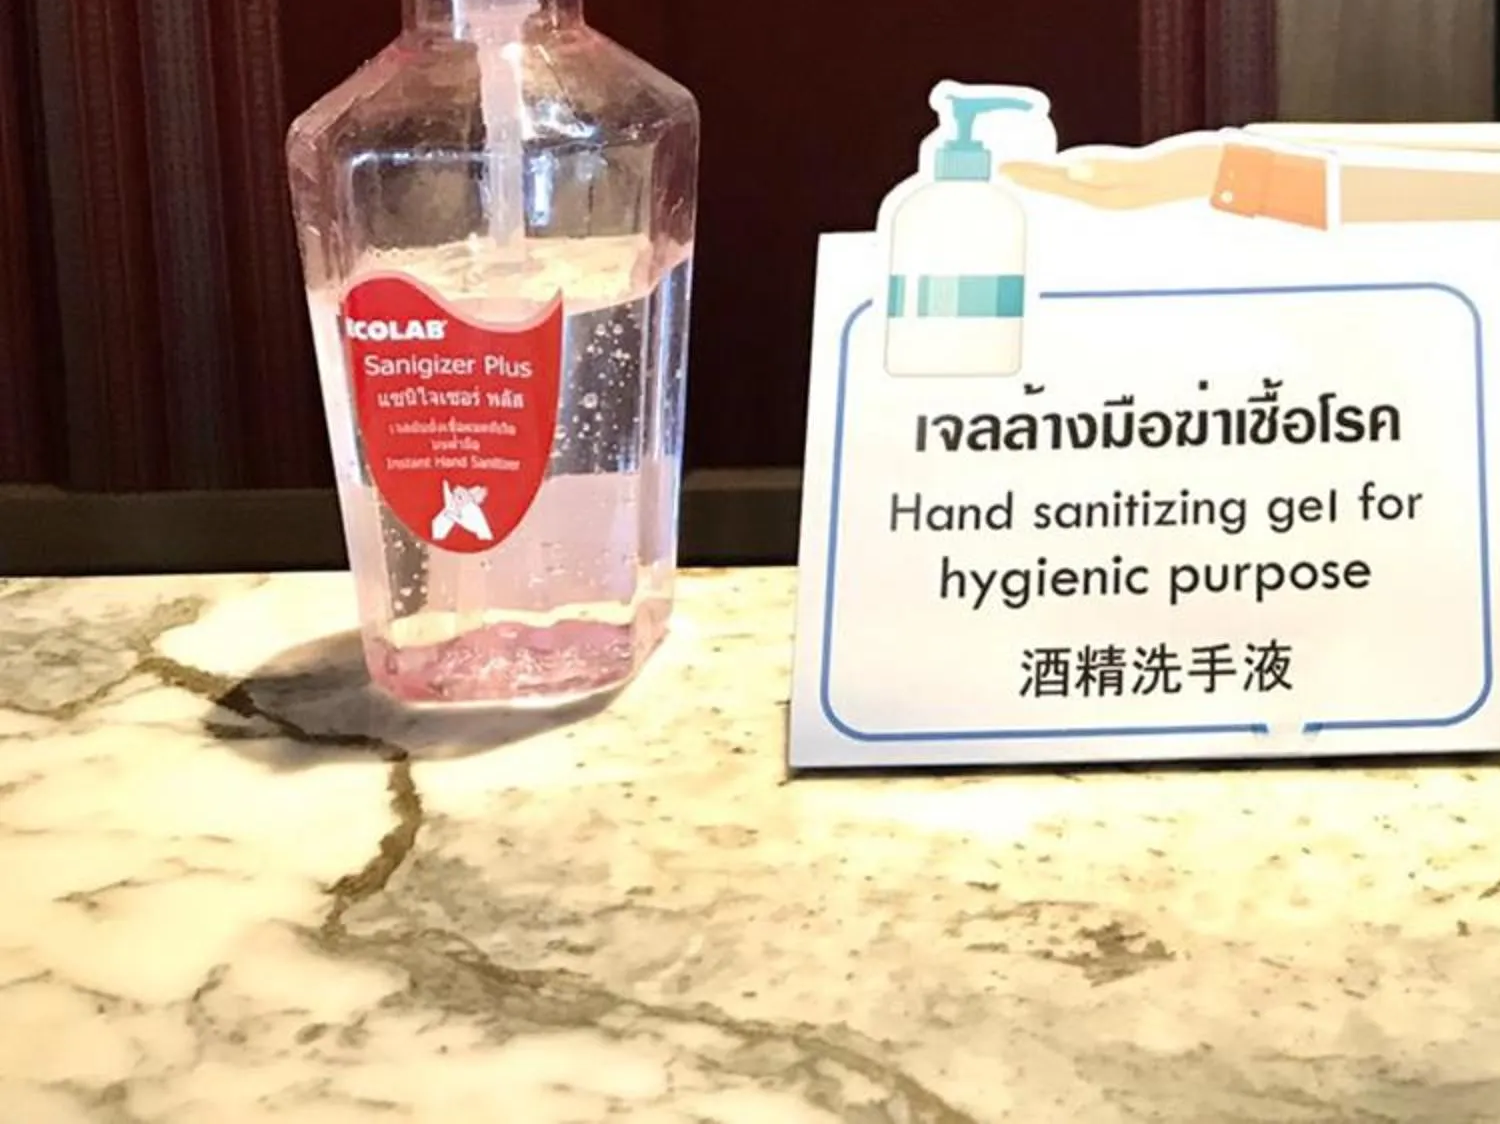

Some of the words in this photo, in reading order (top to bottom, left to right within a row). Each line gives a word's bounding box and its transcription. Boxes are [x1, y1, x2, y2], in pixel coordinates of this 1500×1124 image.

[364, 355, 476, 379] Sanigizer
[484, 354, 533, 377] Plus
[915, 378, 1402, 452] เจลล้างมือฆ่าเชื้อโรค
[889, 491, 1014, 532] Hand
[1033, 487, 1247, 535] sanitizing
[1266, 488, 1338, 533] gel
[1357, 481, 1424, 521] for
[940, 555, 1150, 610] hygienic
[1168, 558, 1373, 605] purpose
[1019, 638, 1294, 698] 酒精洗手液
